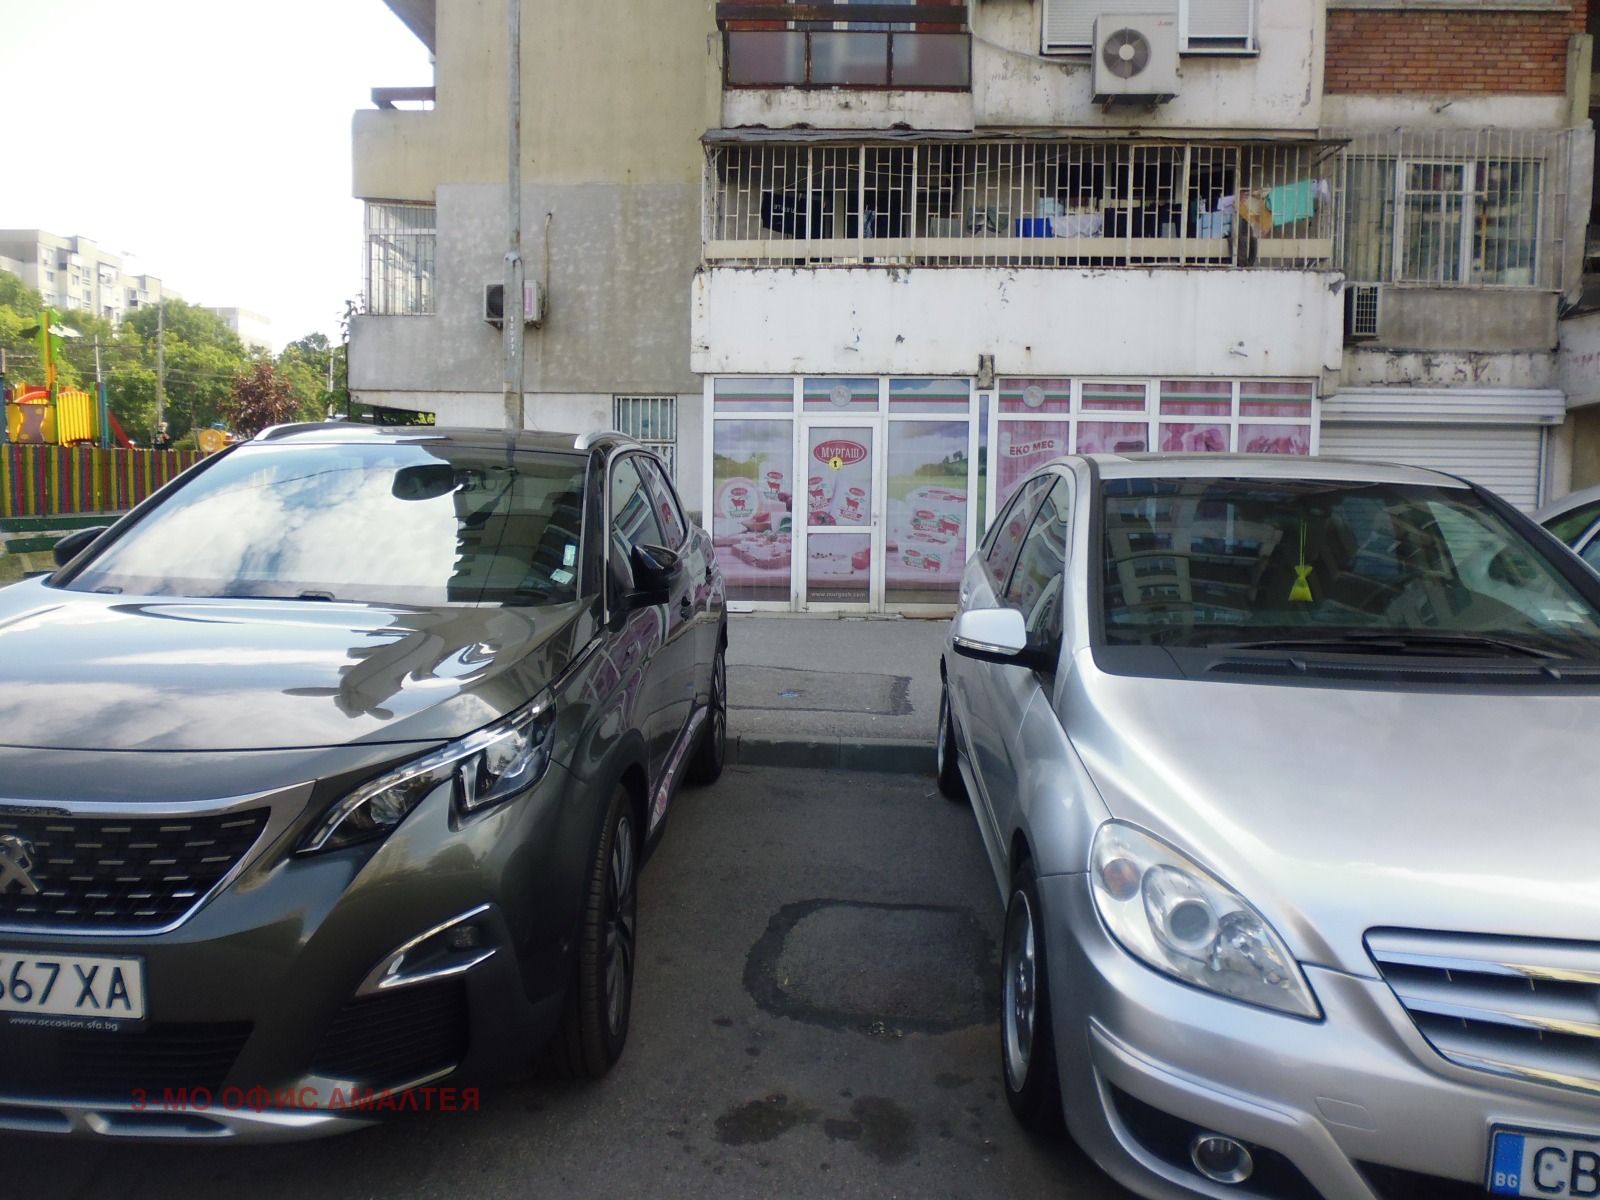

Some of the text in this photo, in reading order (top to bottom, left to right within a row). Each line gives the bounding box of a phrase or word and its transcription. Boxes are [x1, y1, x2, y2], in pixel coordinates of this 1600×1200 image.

[1009, 440, 1055, 456] ЕКО МЕС
[0, 960, 132, 1010] 67 XA
[1495, 1172, 1518, 1188] BG
[1533, 1147, 1600, 1198] CB
